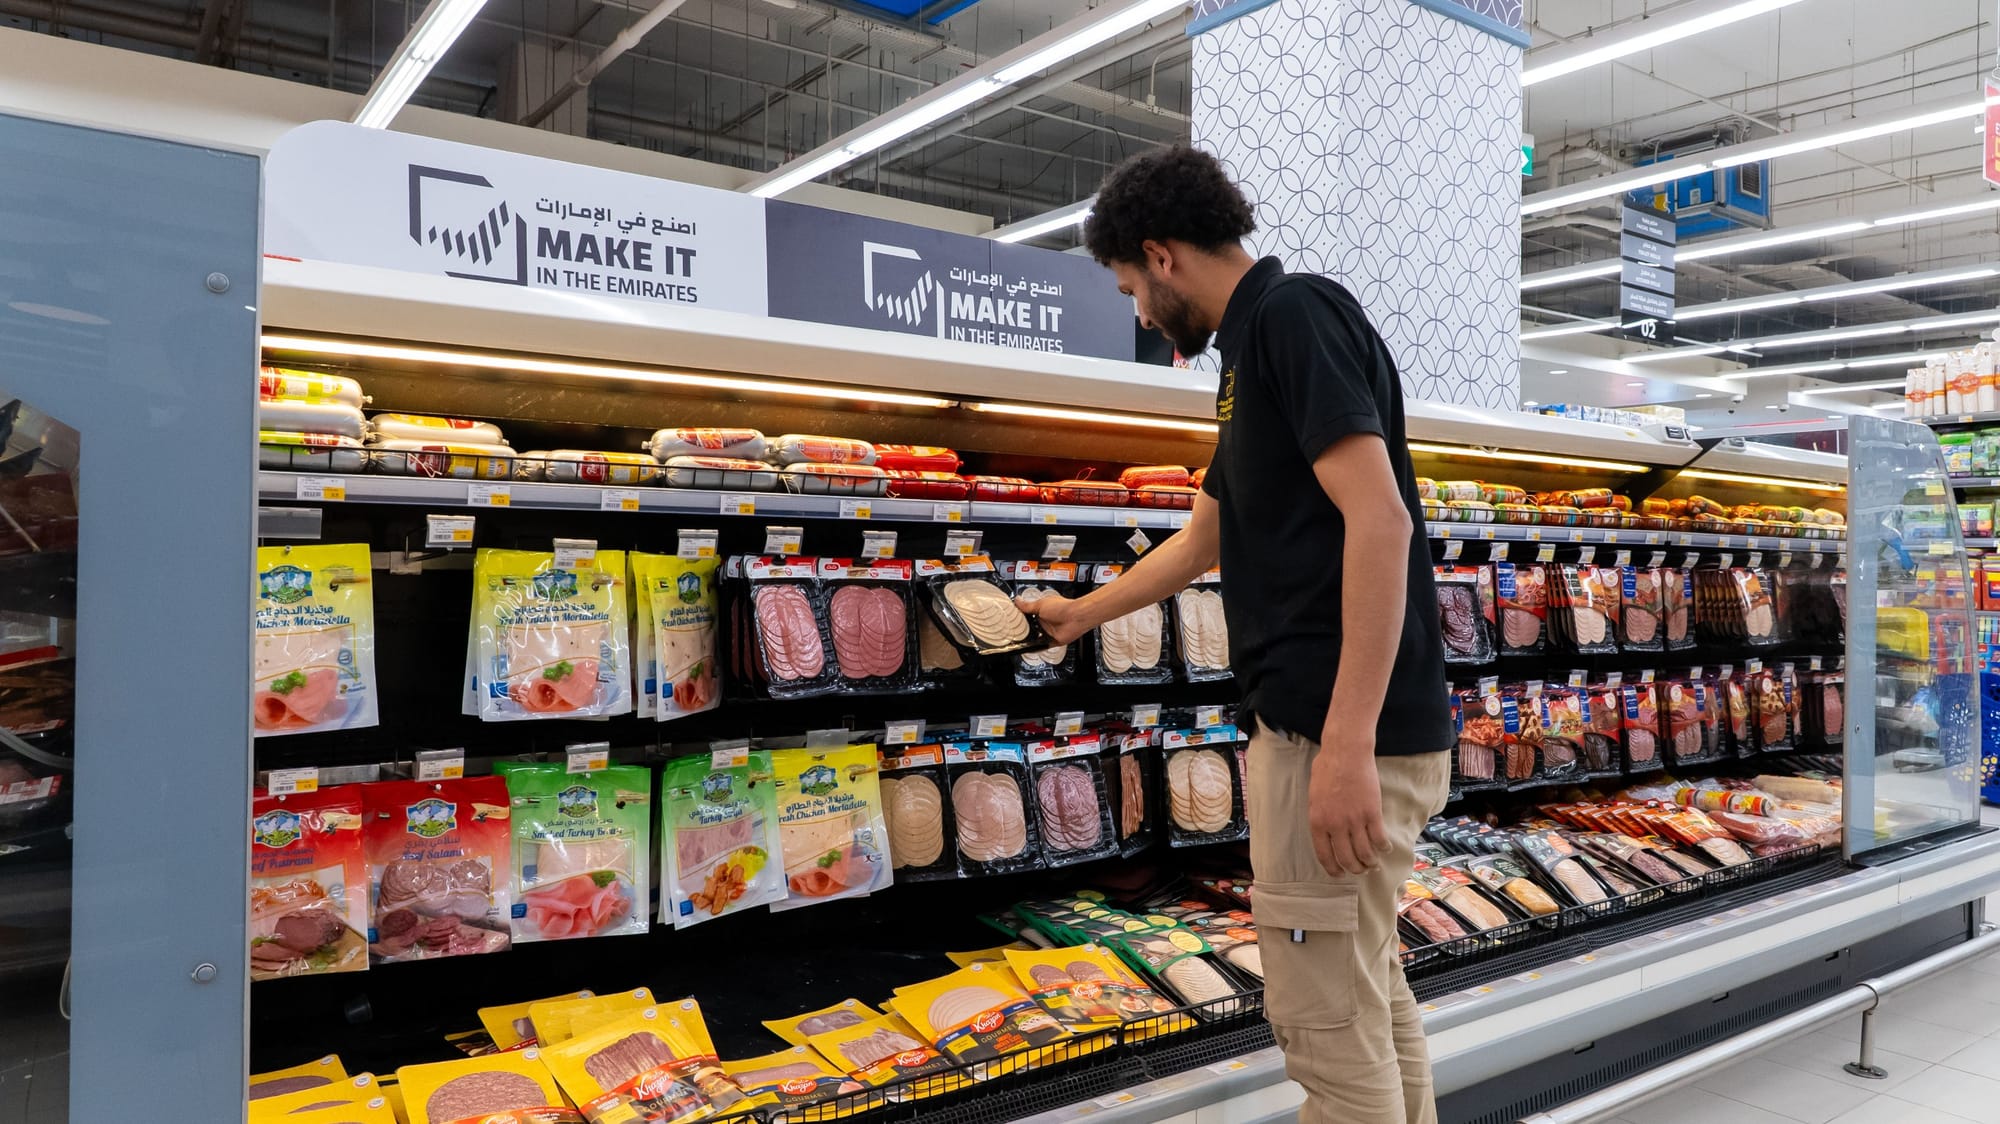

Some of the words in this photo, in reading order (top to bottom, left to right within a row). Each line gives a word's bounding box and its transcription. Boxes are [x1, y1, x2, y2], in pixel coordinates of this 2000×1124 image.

[536, 198, 611, 227] الإمارات
[617, 211, 646, 234] في
[652, 217, 696, 236] اصنع
[537, 227, 653, 272] MAKE
[664, 245, 697, 278] IT
[537, 266, 557, 285] IN
[563, 270, 601, 291] THE
[606, 276, 698, 303] EMIRATES
[950, 267, 1003, 291] الإمارات
[1006, 276, 1027, 297] في
[1030, 280, 1062, 298] اصنع
[950, 291, 1032, 328] MAKE
[1039, 304, 1063, 333] IT
[950, 325, 965, 341] IN
[968, 328, 995, 345] THE
[998, 332, 1063, 354] EMIRATES
[1641, 321, 1656, 338] 02
[256, 618, 290, 629] hicken
[779, 814, 794, 823] resh
[828, 800, 867, 813] Mortadella
[532, 829, 565, 839] Smked
[566, 828, 595, 839] Turkey
